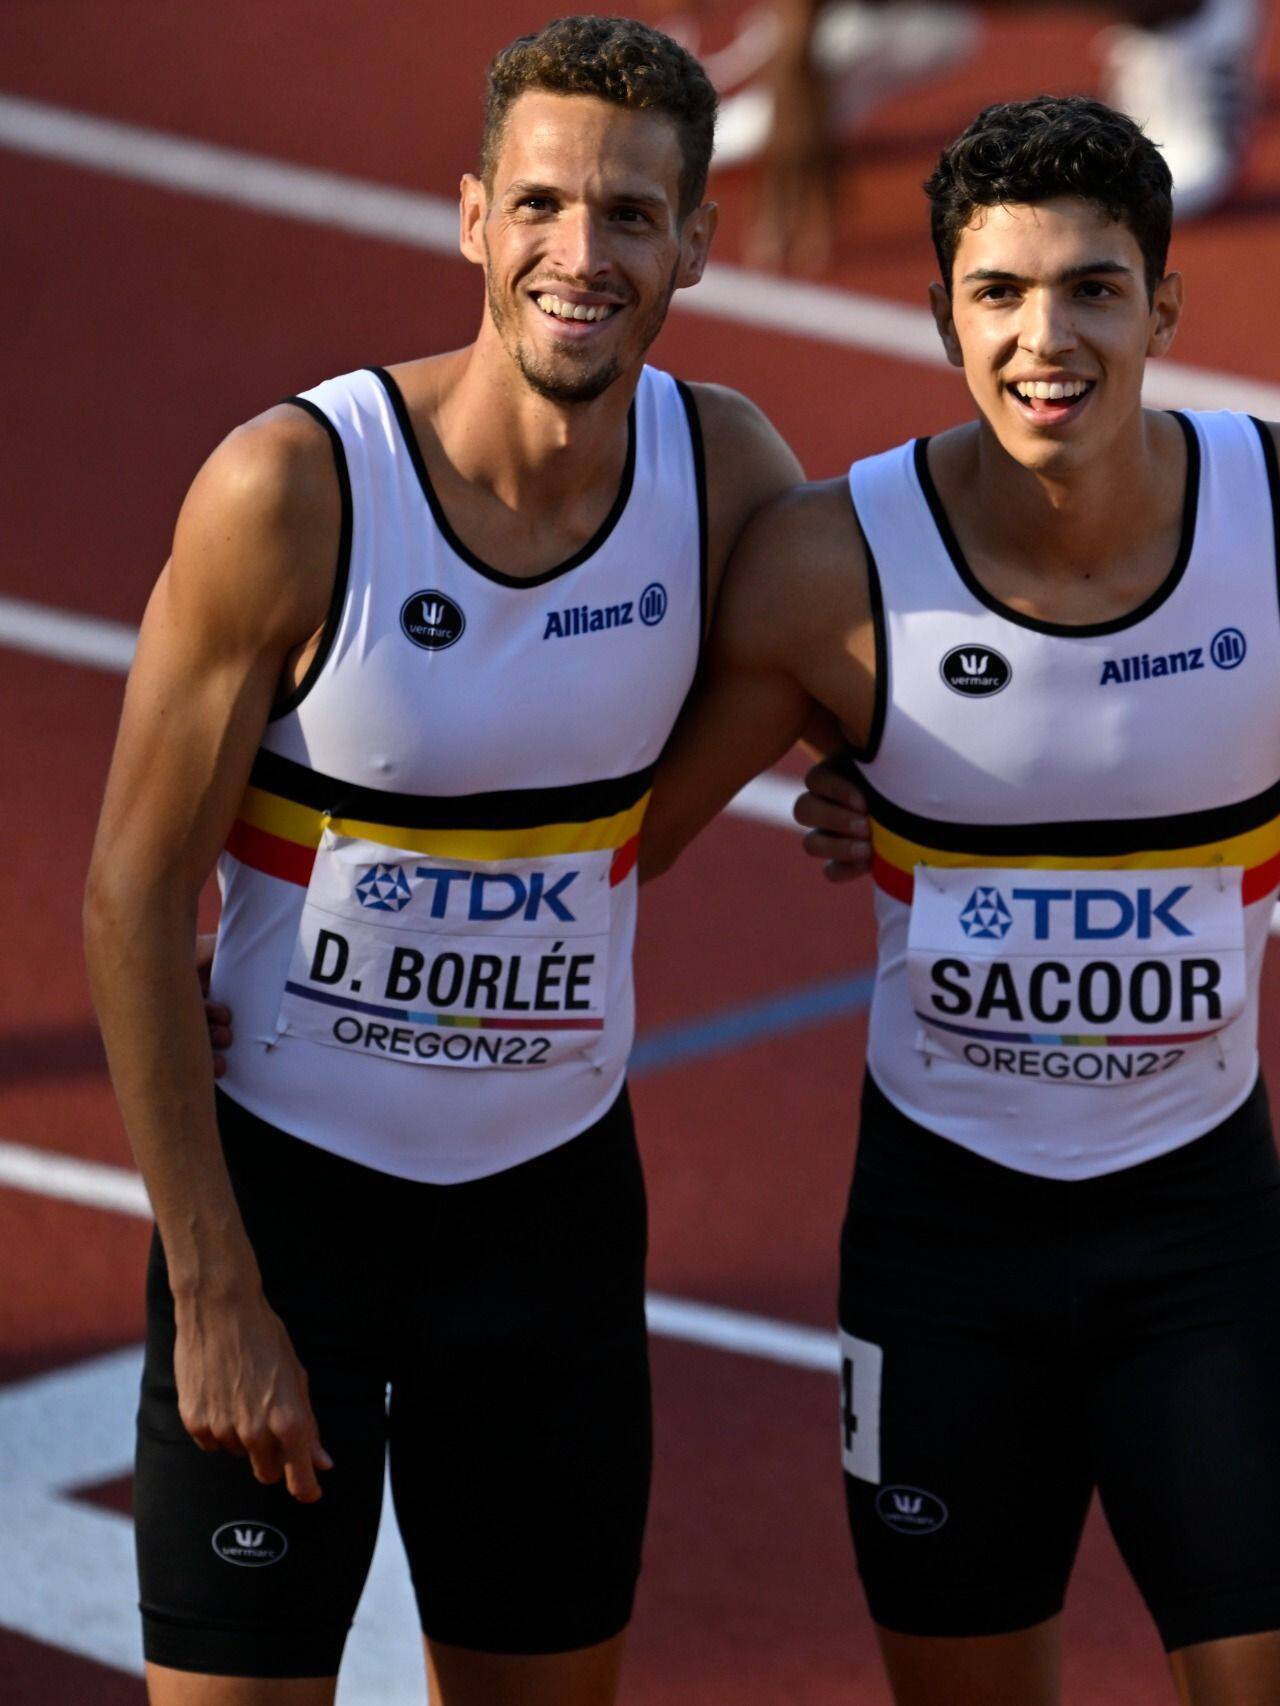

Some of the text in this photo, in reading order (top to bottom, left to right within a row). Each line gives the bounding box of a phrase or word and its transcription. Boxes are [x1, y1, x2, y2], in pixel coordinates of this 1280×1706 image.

[542, 601, 634, 641] Allianz
[950, 675, 1000, 688] vermarc
[1099, 647, 1205, 686] Allianz
[416, 866, 580, 922] TDK
[1012, 885, 1194, 940] TDK
[309, 928, 596, 1012] D. BORLÉE
[930, 958, 1222, 1024] SACOOR
[332, 1016, 552, 1065] OREGON22
[963, 1043, 1186, 1081] OREGON22
